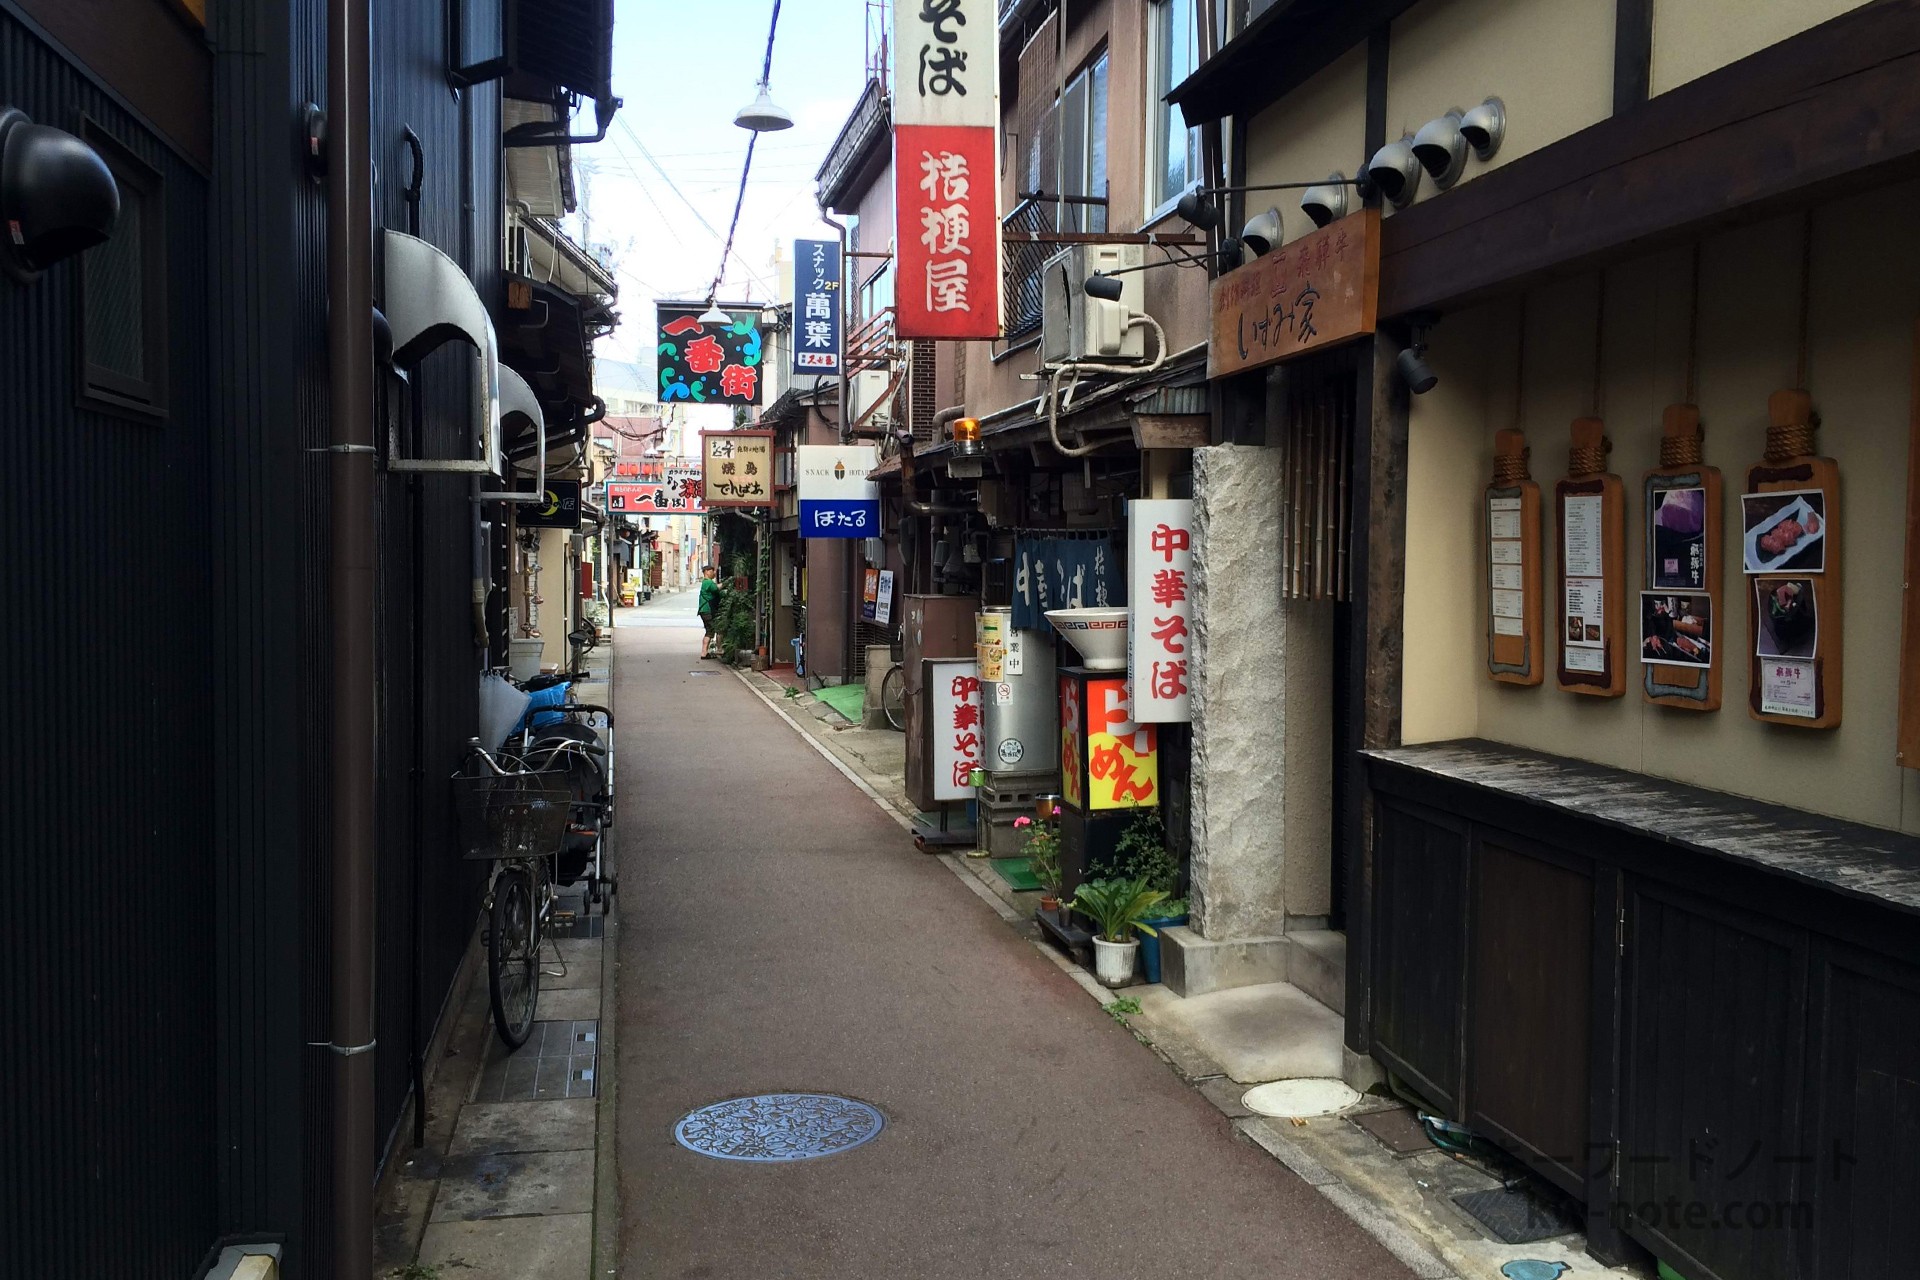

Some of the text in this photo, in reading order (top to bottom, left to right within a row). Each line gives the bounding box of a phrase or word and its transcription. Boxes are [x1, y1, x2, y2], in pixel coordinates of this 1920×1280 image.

[918, 0, 968, 97] そば
[812, 244, 825, 290] スナック
[919, 150, 972, 313] 桔梗屋
[804, 292, 832, 348] 萬葉
[824, 281, 839, 291] 2F
[662, 315, 757, 401] 一番街
[814, 510, 867, 528] ほたる
[1150, 523, 1190, 700] 中華そば
[952, 675, 980, 788] 中華そば
